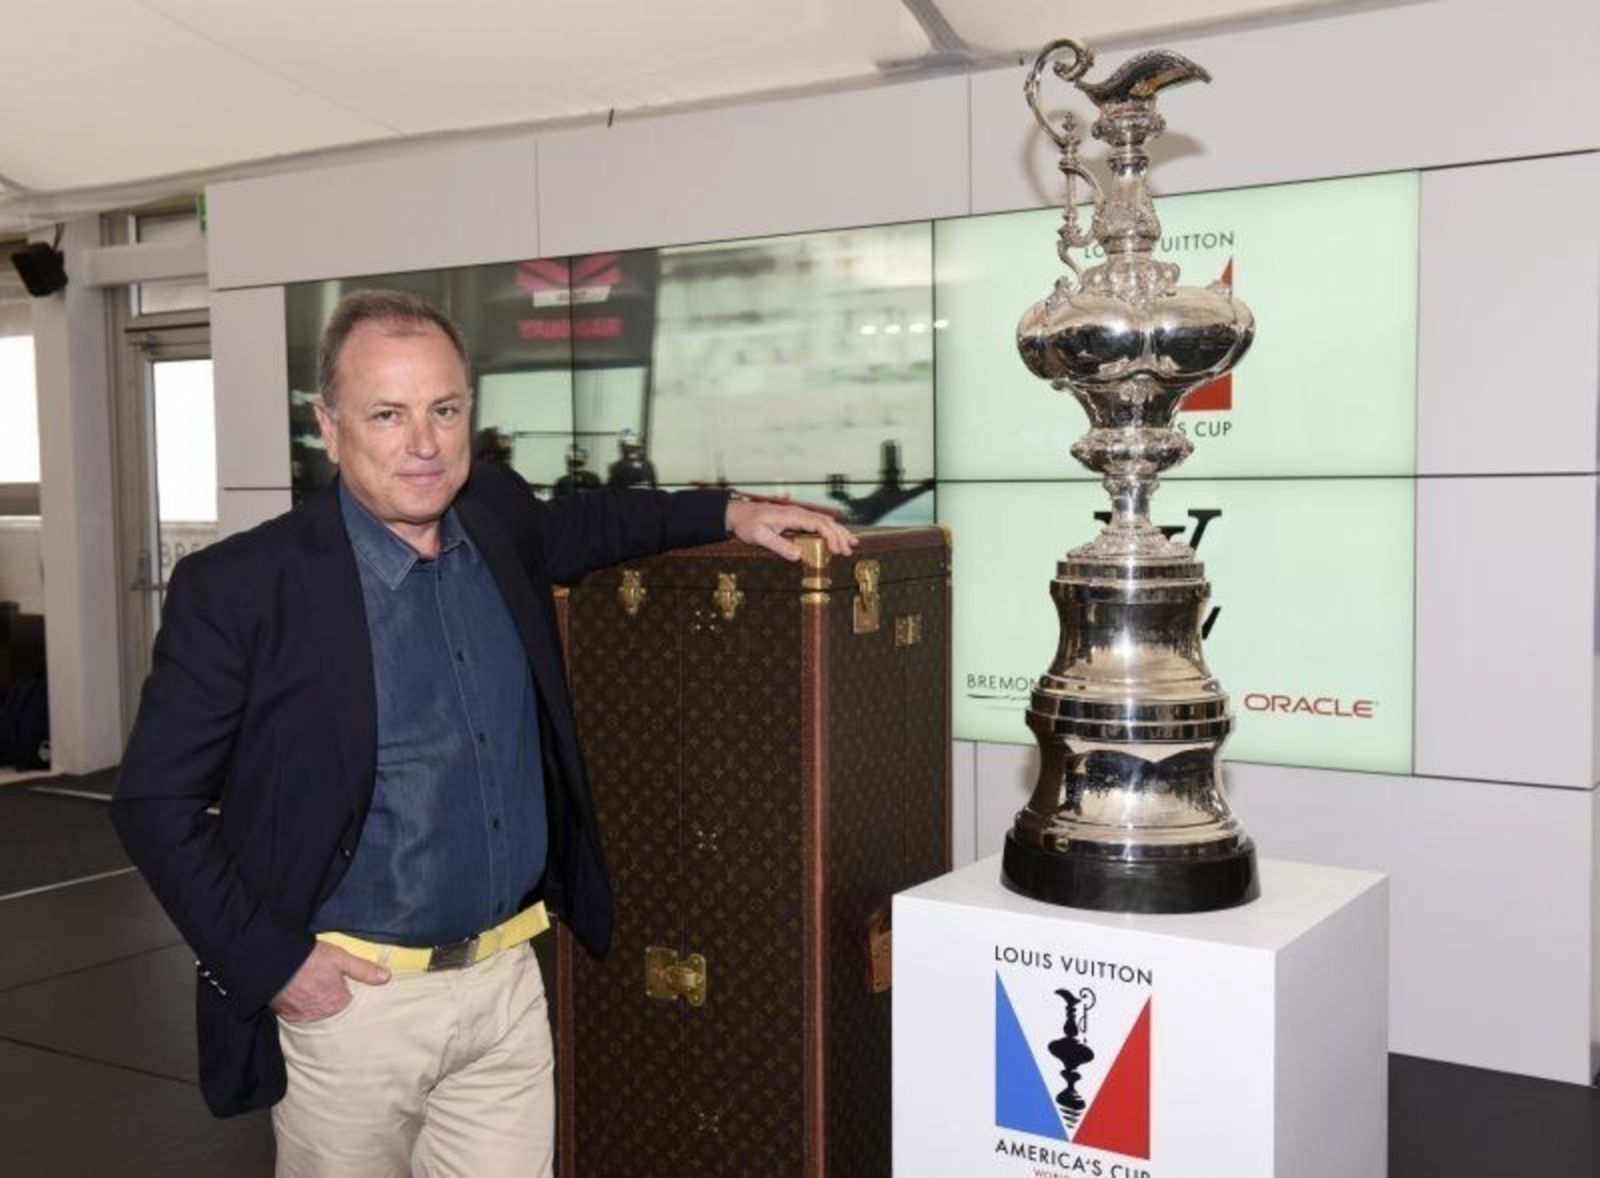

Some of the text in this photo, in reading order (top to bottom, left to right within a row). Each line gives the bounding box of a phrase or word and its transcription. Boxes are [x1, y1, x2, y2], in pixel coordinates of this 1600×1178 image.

[1161, 231, 1234, 253] UITTON
[1194, 421, 1232, 437] CUP
[1244, 693, 1373, 718] ORACLE
[995, 945, 1153, 986] LOUIS VUITTON
[995, 1139, 1102, 1176] AMERICA'S
